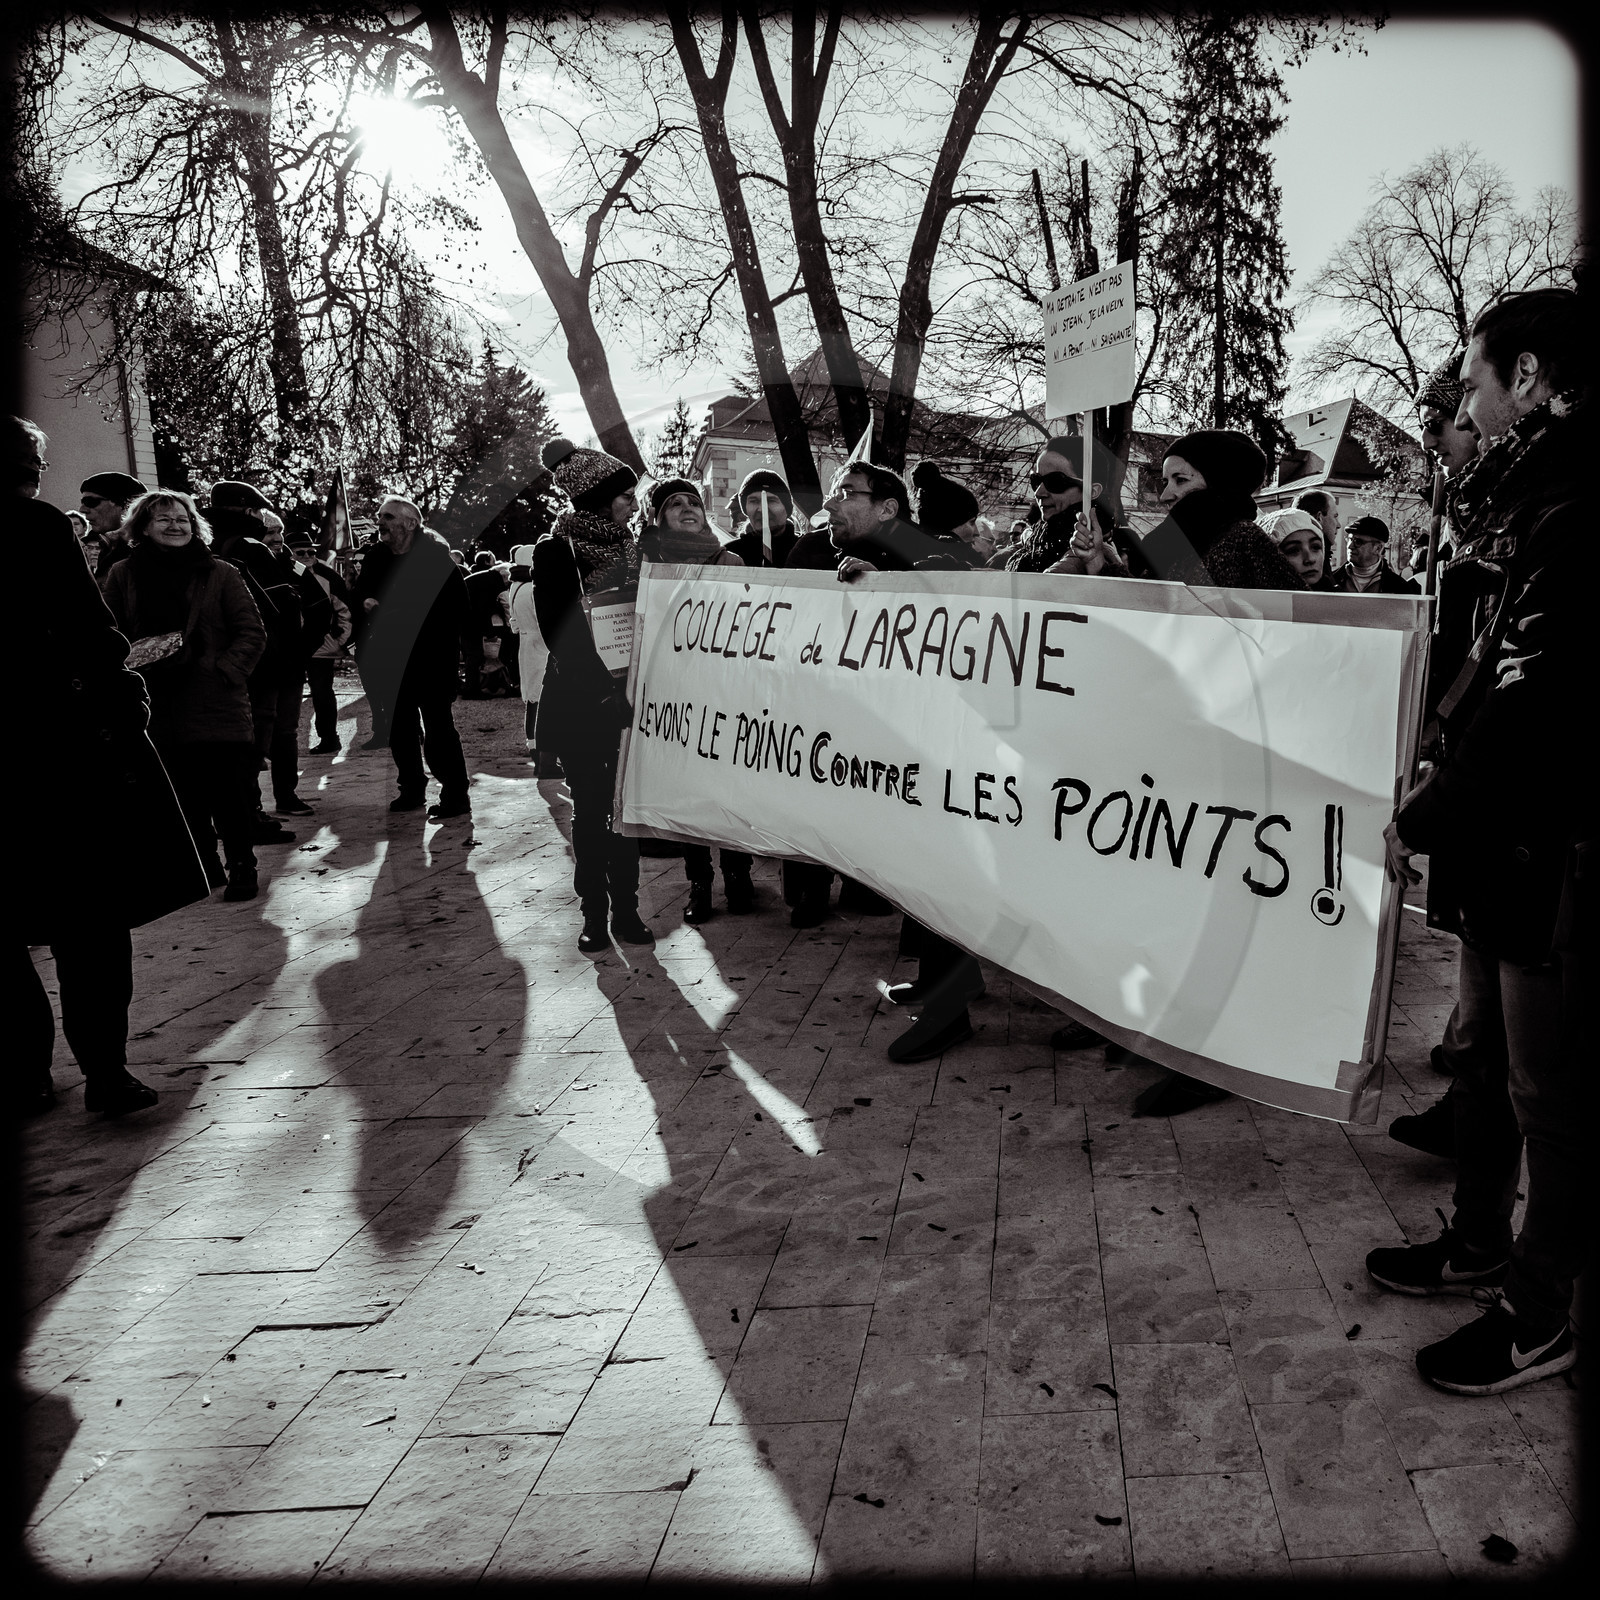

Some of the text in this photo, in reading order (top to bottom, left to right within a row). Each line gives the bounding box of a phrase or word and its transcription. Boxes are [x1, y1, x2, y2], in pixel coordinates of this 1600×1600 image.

[1046, 301, 1055, 315] MA
[1056, 287, 1086, 312] RETRAITE
[1108, 273, 1123, 291] PAS
[1086, 308, 1097, 330] JE
[1097, 304, 1105, 318] LA
[1105, 297, 1125, 314] VEUX
[800, 623, 823, 666] de
[837, 603, 1089, 697] LARAGNE
[638, 683, 693, 748] LEVONS
[698, 705, 726, 760] LE
[943, 768, 1023, 827] LES
